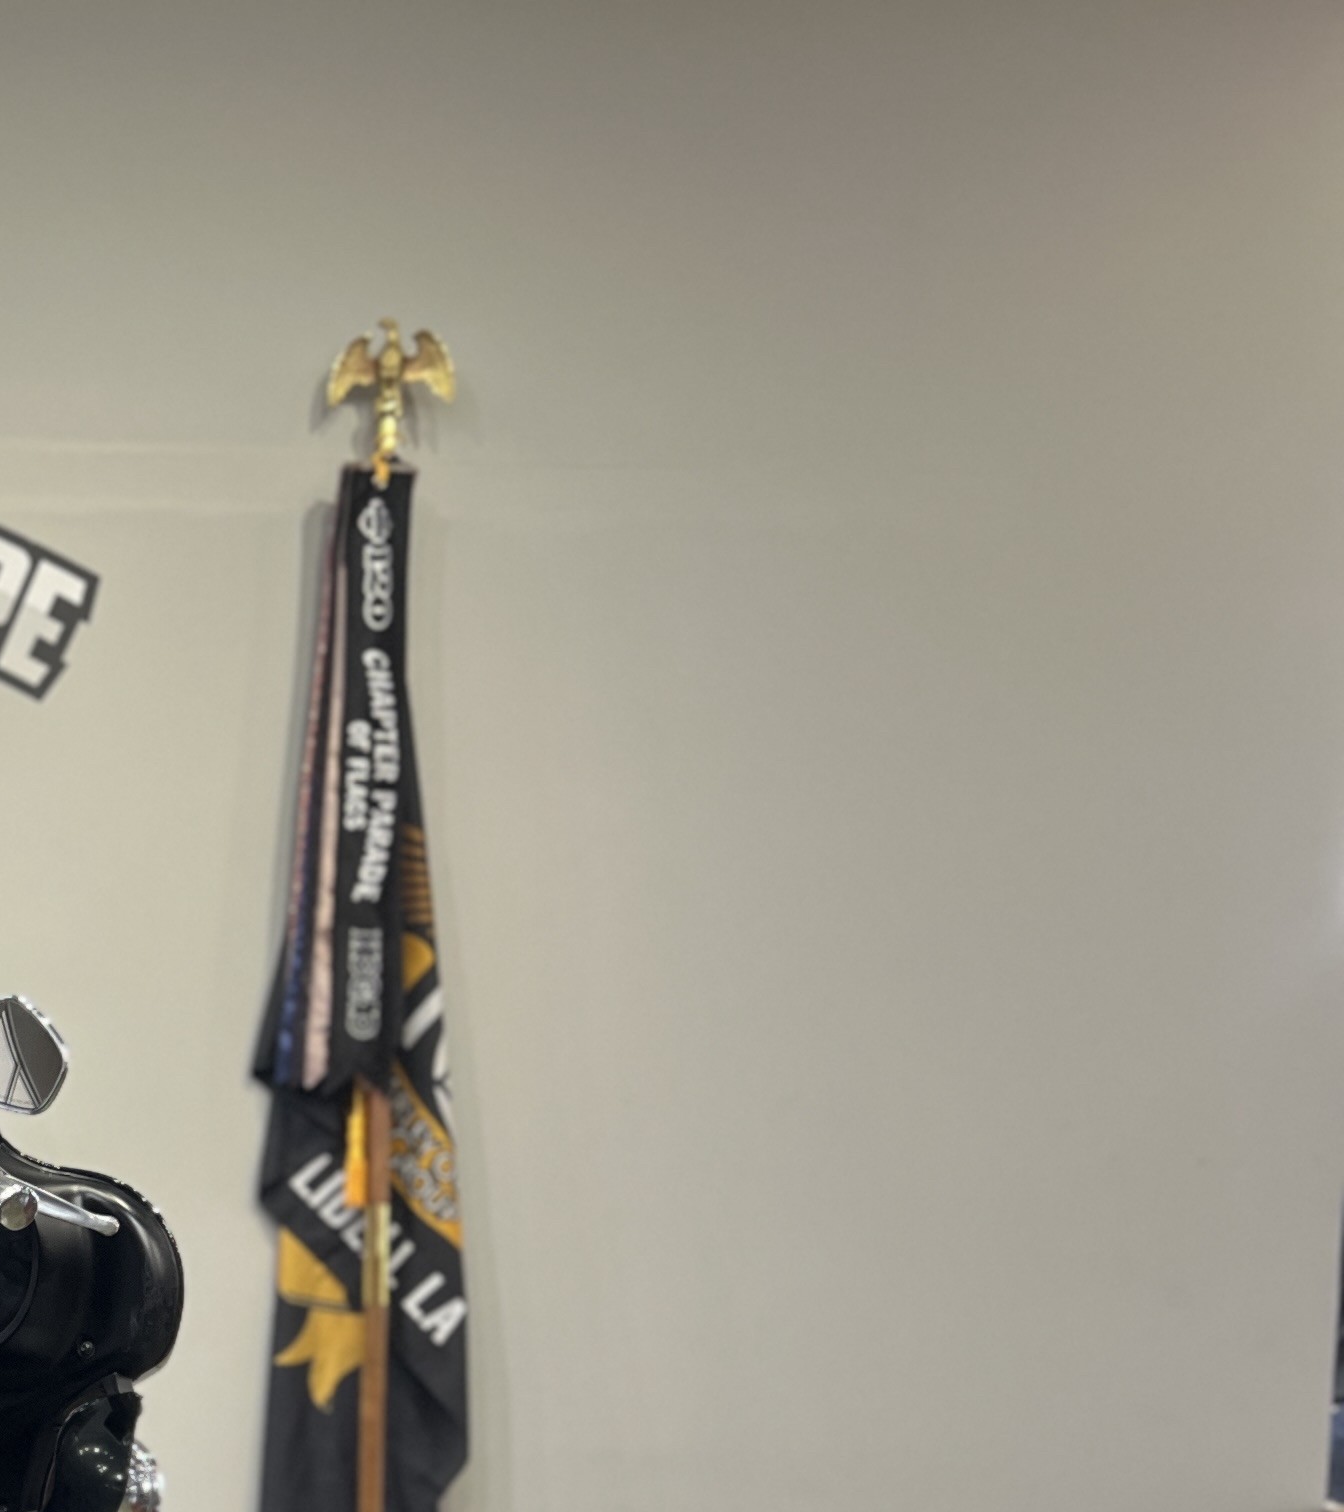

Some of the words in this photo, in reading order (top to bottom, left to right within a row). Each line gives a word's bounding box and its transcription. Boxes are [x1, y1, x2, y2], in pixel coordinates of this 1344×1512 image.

[362, 647, 400, 784] CHAPTER
[350, 788, 398, 904] PARADE
[400, 1270, 468, 1346] LA
